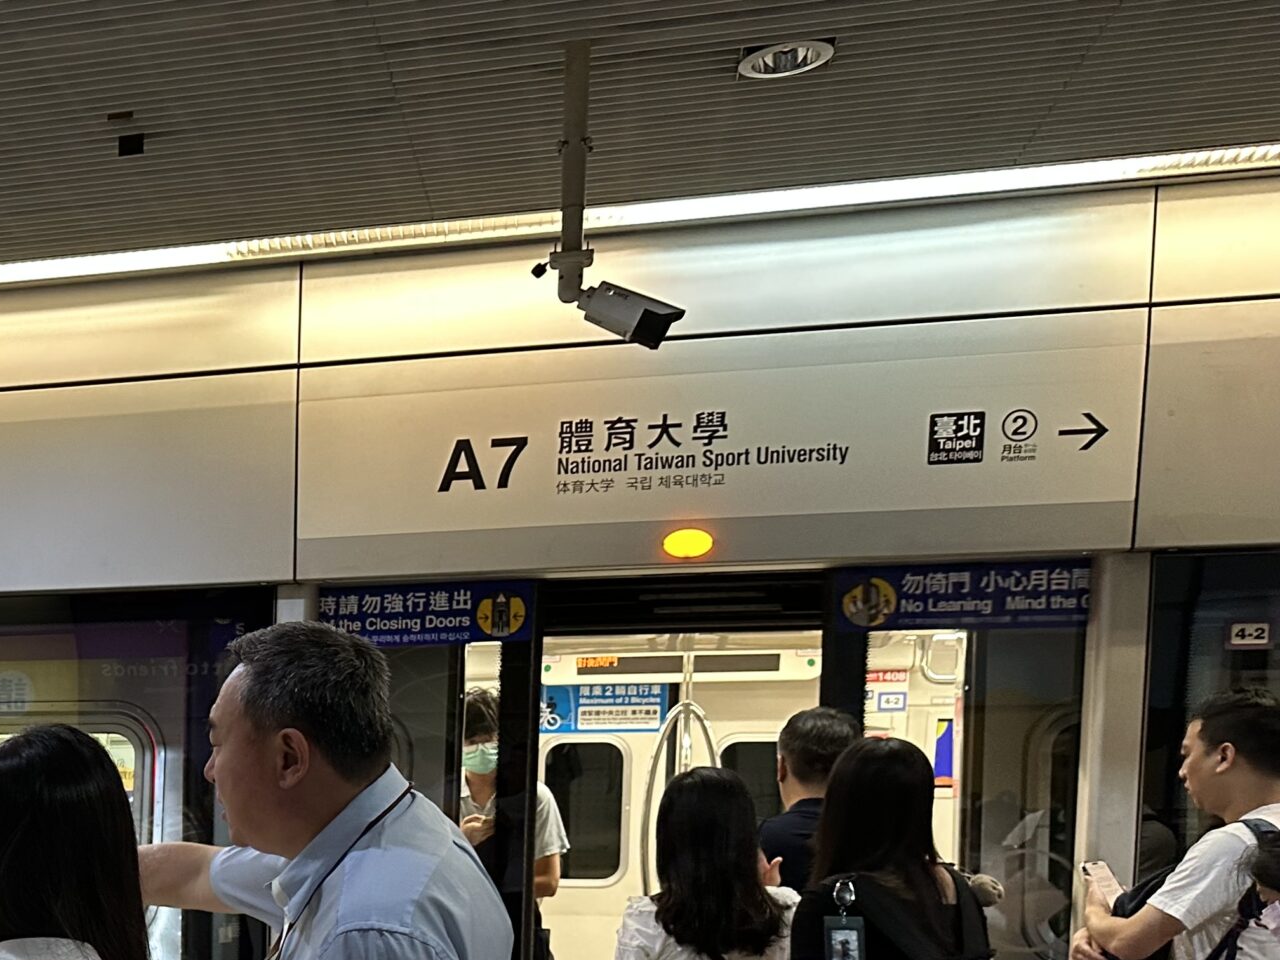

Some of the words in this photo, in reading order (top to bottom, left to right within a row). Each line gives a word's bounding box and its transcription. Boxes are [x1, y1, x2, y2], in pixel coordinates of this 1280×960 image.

[558, 411, 729, 455] 體育大學
[933, 414, 981, 439] 臺北
[938, 437, 976, 451] Taipei
[1001, 443, 1022, 454] 月台
[437, 436, 529, 493] A7
[557, 453, 628, 475] National
[634, 452, 697, 471] Taiwan
[702, 449, 750, 470] Sport
[756, 443, 849, 466] University
[556, 477, 615, 495] 体育大学
[626, 475, 652, 491] 국립
[658, 473, 726, 489] 체육대학교
[902, 572, 970, 594] 勿倚門
[900, 599, 923, 613] No
[928, 597, 992, 614] Leaning
[1005, 596, 1046, 610] Mind
[1050, 595, 1077, 609] the
[365, 616, 421, 632] Closing
[425, 615, 470, 629] Doors
[1234, 628, 1266, 640] 4-2
